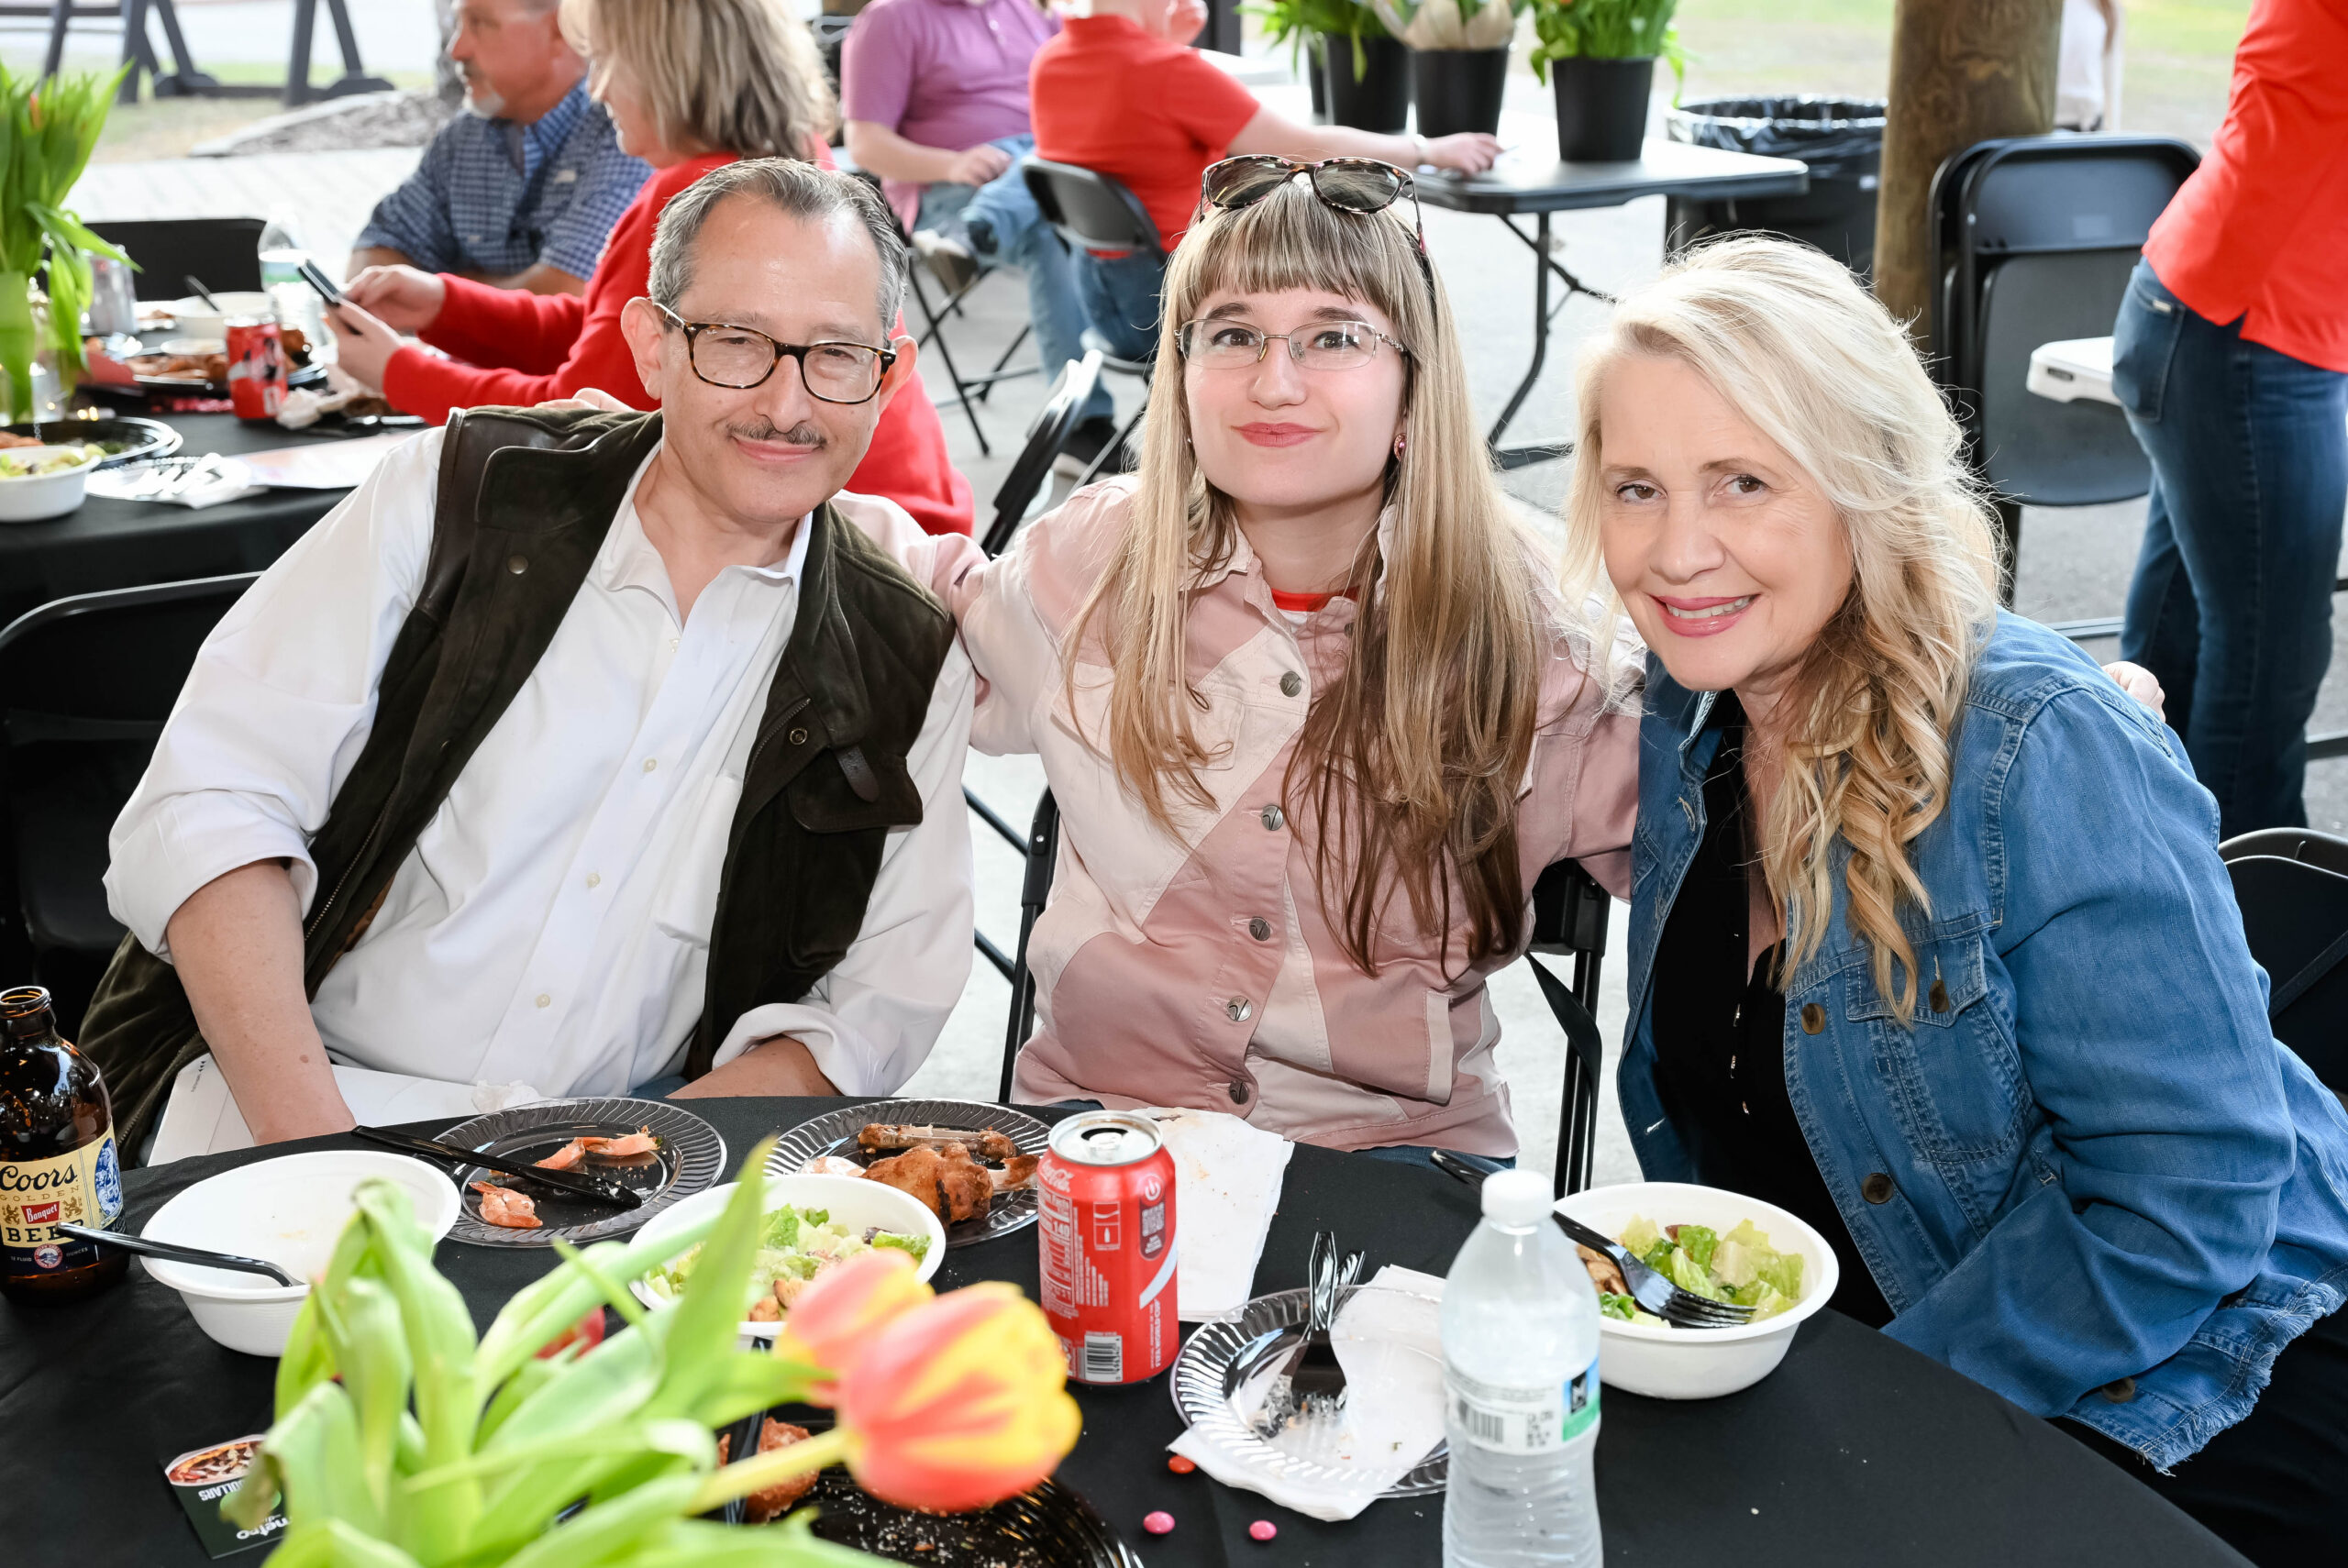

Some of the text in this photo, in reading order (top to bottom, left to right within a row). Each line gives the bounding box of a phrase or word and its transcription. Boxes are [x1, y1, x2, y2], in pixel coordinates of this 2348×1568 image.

[0, 1164, 78, 1191] Coors
[0, 1186, 80, 1201] GOLDEN
[26, 1204, 58, 1222] Banquet
